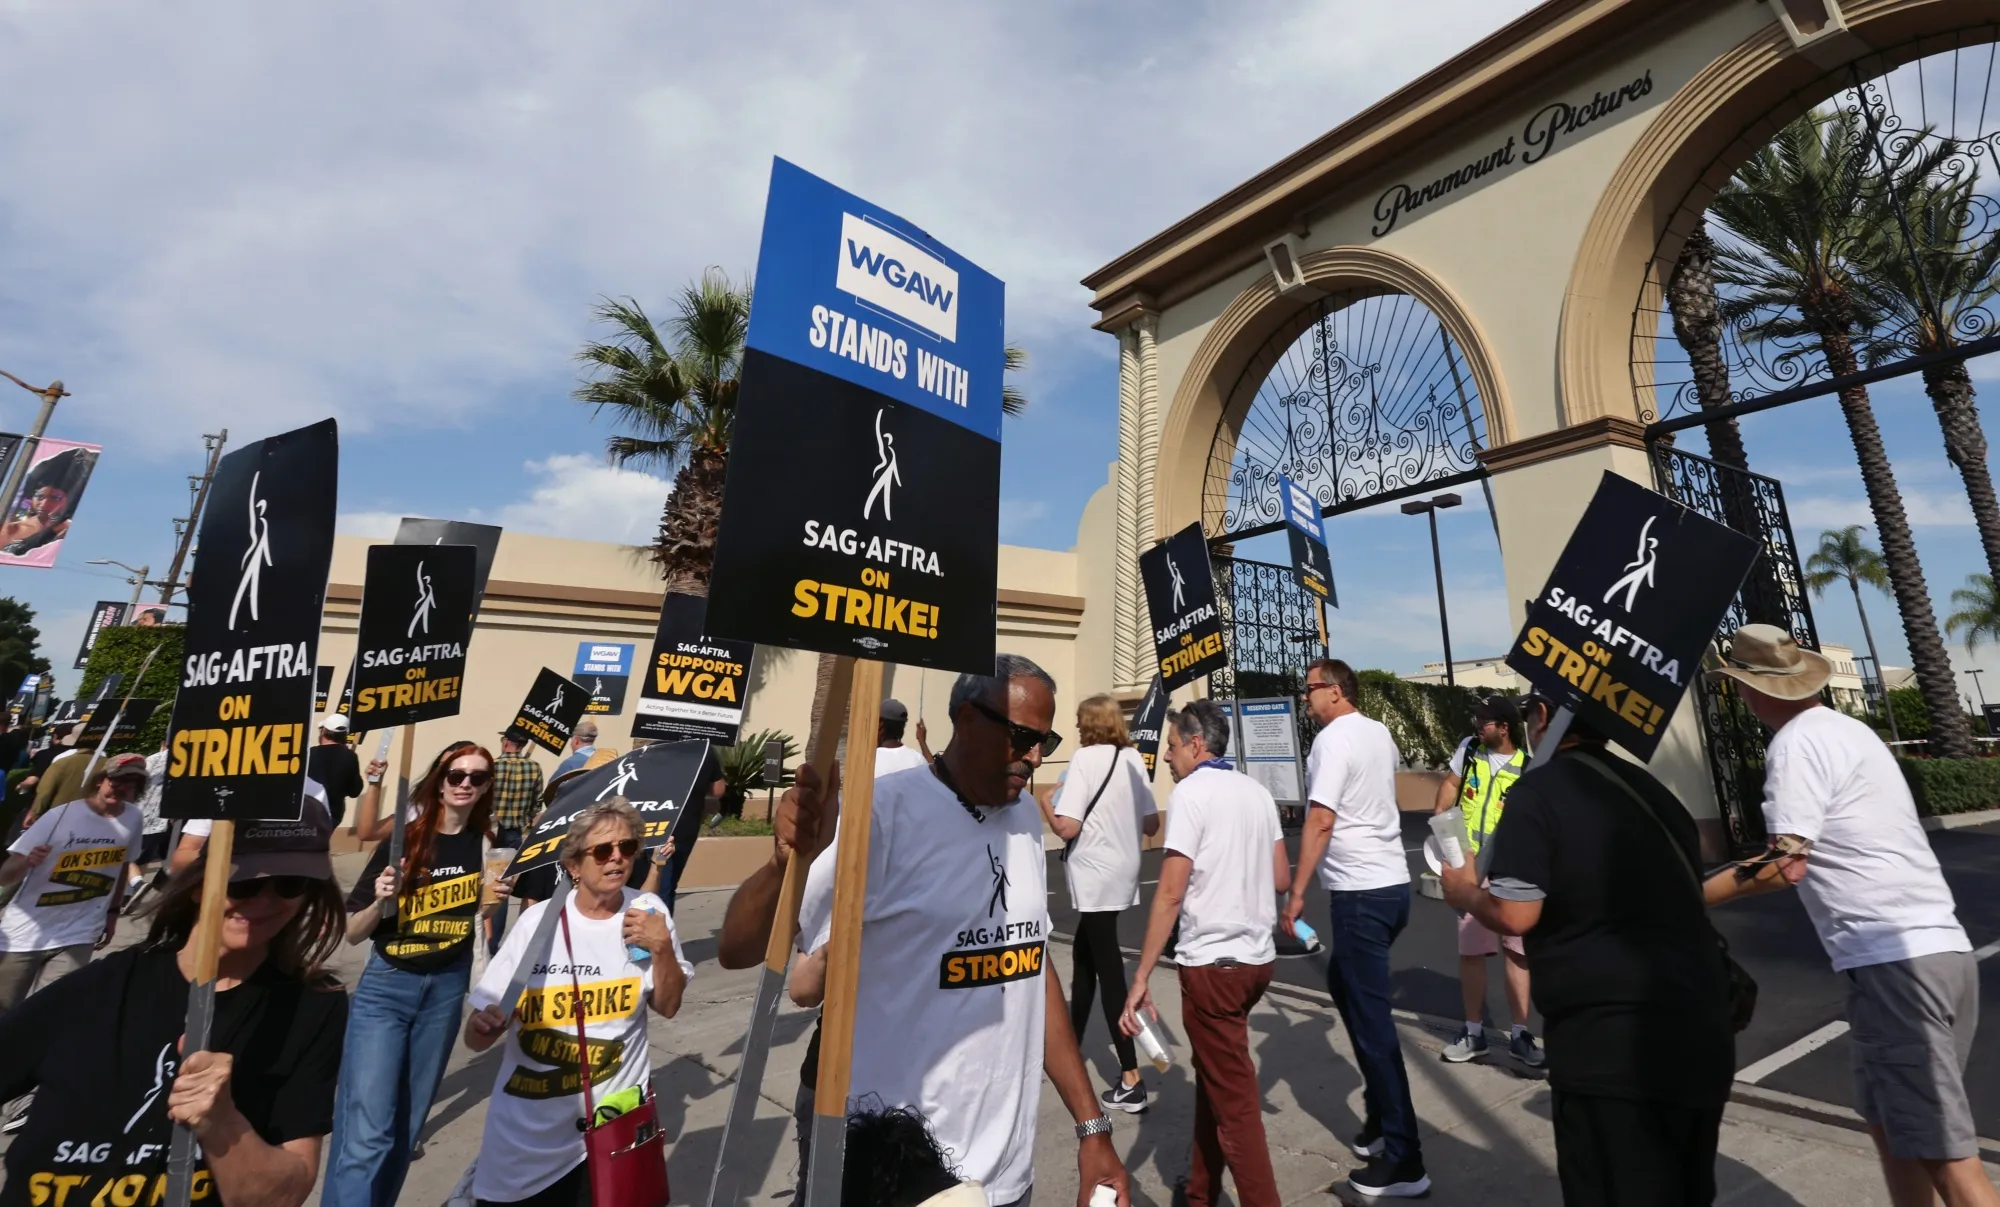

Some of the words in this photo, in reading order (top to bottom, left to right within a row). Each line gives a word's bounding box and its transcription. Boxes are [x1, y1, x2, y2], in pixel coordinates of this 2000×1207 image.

[1371, 135, 1516, 238] Paramount
[1521, 68, 1653, 164] Pictures
[847, 238, 954, 313] WGAW
[809, 304, 908, 380] STANDS
[917, 347, 969, 408] WITH
[860, 567, 890, 590] ON
[791, 578, 940, 640] STRIKE!
[1160, 631, 1224, 679] STRIKE!
[1180, 632, 1193, 647] ON
[1582, 640, 1613, 668] ON
[405, 667, 427, 681] ON
[658, 653, 743, 677] SUPPORTS
[1521, 626, 1665, 736] STRIKE!
[356, 676, 460, 713] STRIKE!
[656, 667, 737, 703] WGA
[219, 694, 252, 721] ON
[515, 717, 565, 750] STRIKE!
[538, 721, 549, 729] ON
[168, 722, 304, 778] STRIKE!
[516, 820, 670, 864] STE!
[61, 855, 80, 868] ON
[414, 920, 430, 934] ON
[432, 921, 470, 935] STRIKE
[386, 944, 398, 956] ON
[399, 943, 430, 955] STRIKE
[947, 946, 1041, 983] STRONG
[519, 995, 546, 1024] ON
